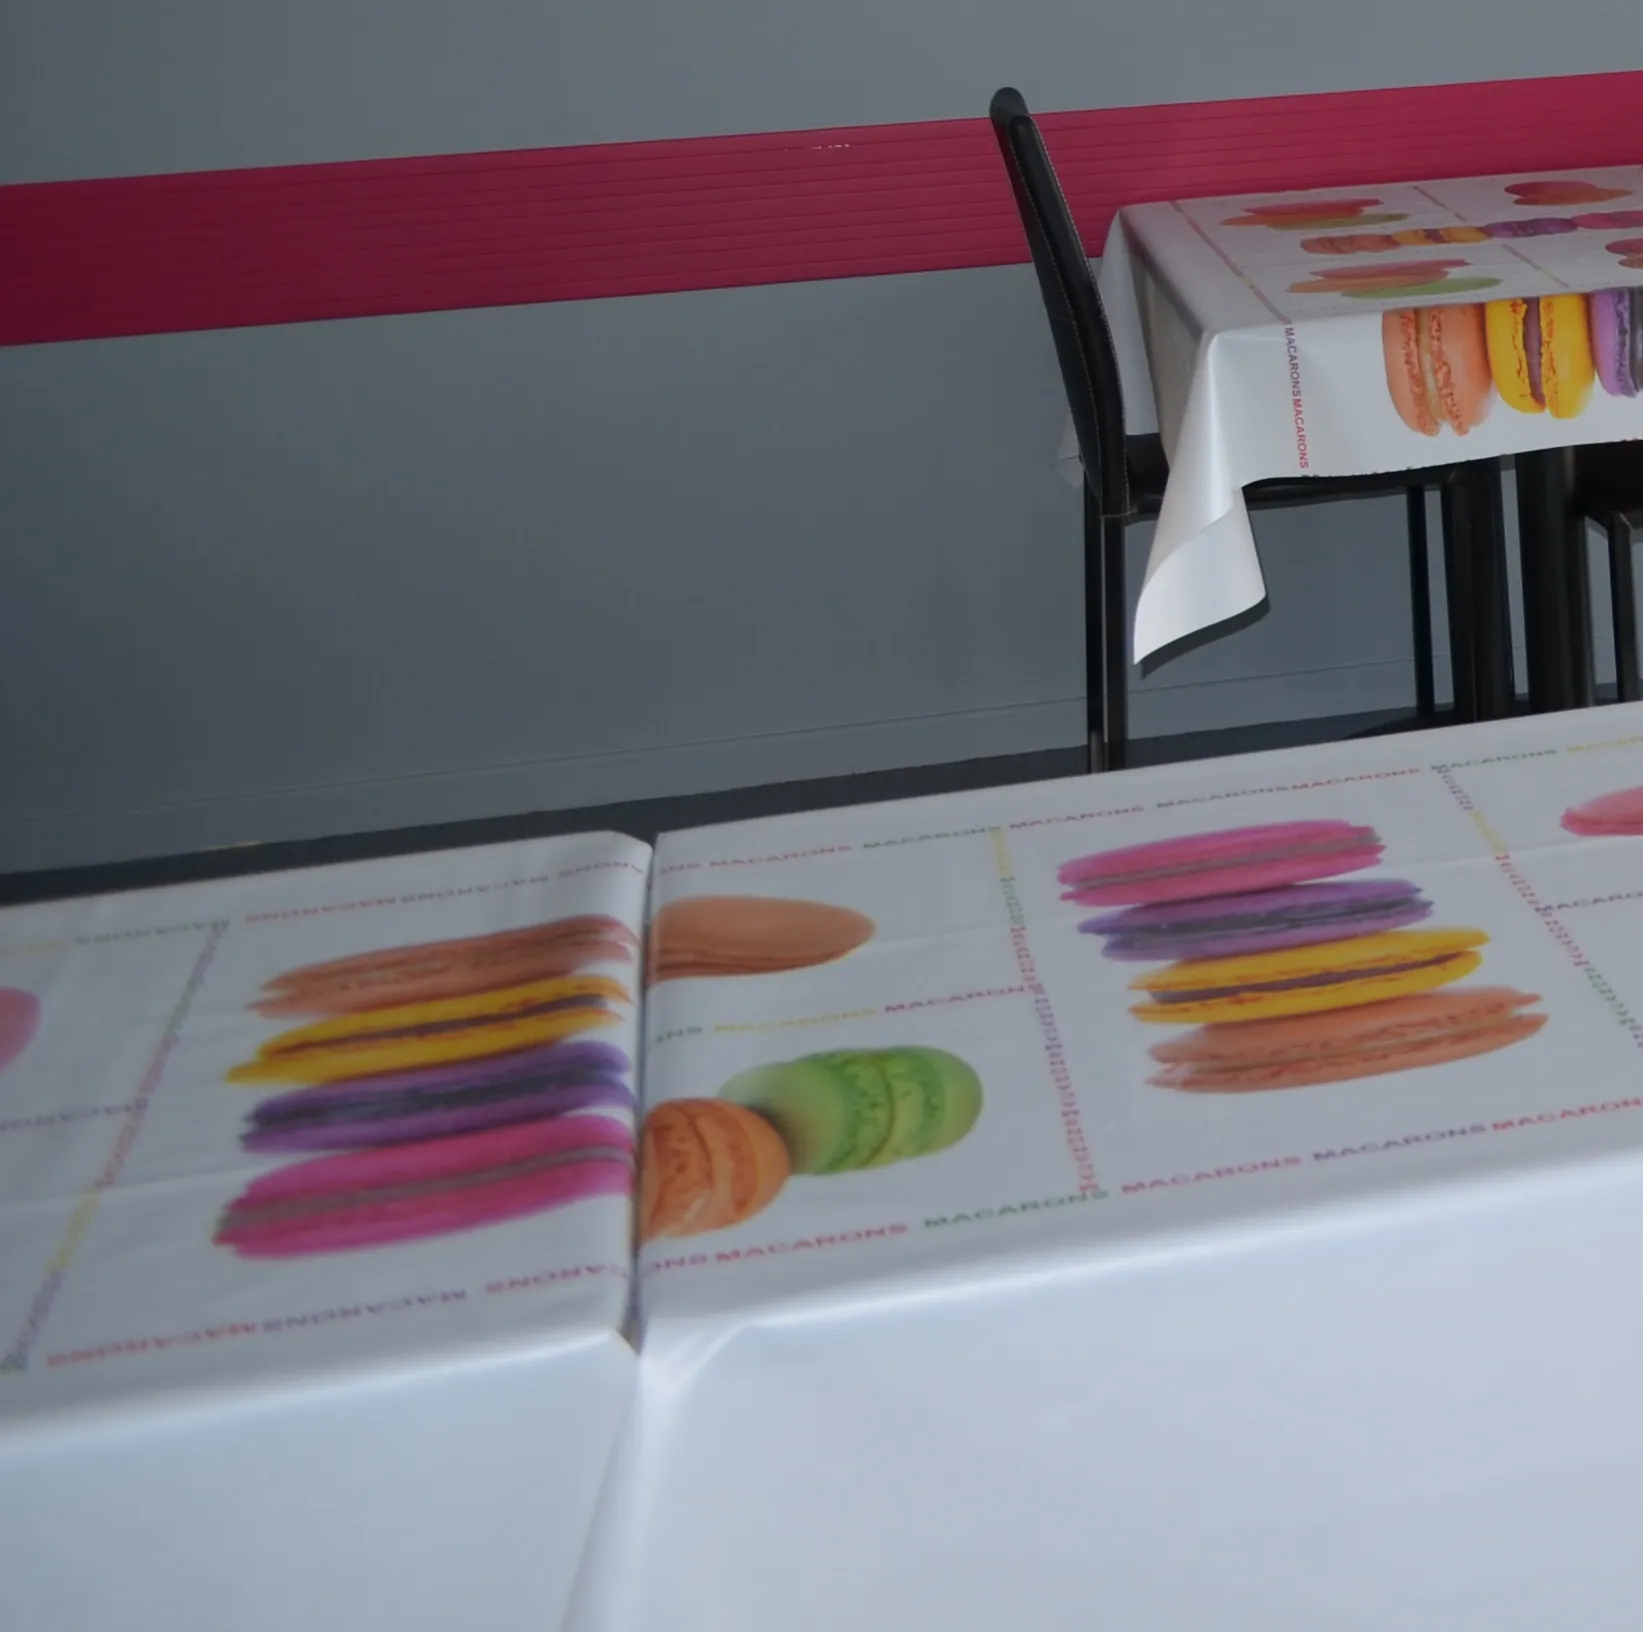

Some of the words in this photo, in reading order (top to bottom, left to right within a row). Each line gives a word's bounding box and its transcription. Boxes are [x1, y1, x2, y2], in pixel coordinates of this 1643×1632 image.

[1285, 327, 1301, 397] MACARONS
[1293, 398, 1309, 469] MACARONS
[709, 843, 853, 868] MACARONS
[1008, 805, 1146, 830] MACARONS
[1155, 784, 1290, 809] MACARONS
[1291, 768, 1423, 791] MACARONS
[714, 1222, 909, 1264] MACARONS
[921, 1186, 1110, 1230] MACARONS
[1120, 1152, 1304, 1196] MACARONS
[1310, 1120, 1489, 1164] MACARONS
[44, 1318, 258, 1368] MACARONS
[260, 1285, 468, 1334] MACARONS
